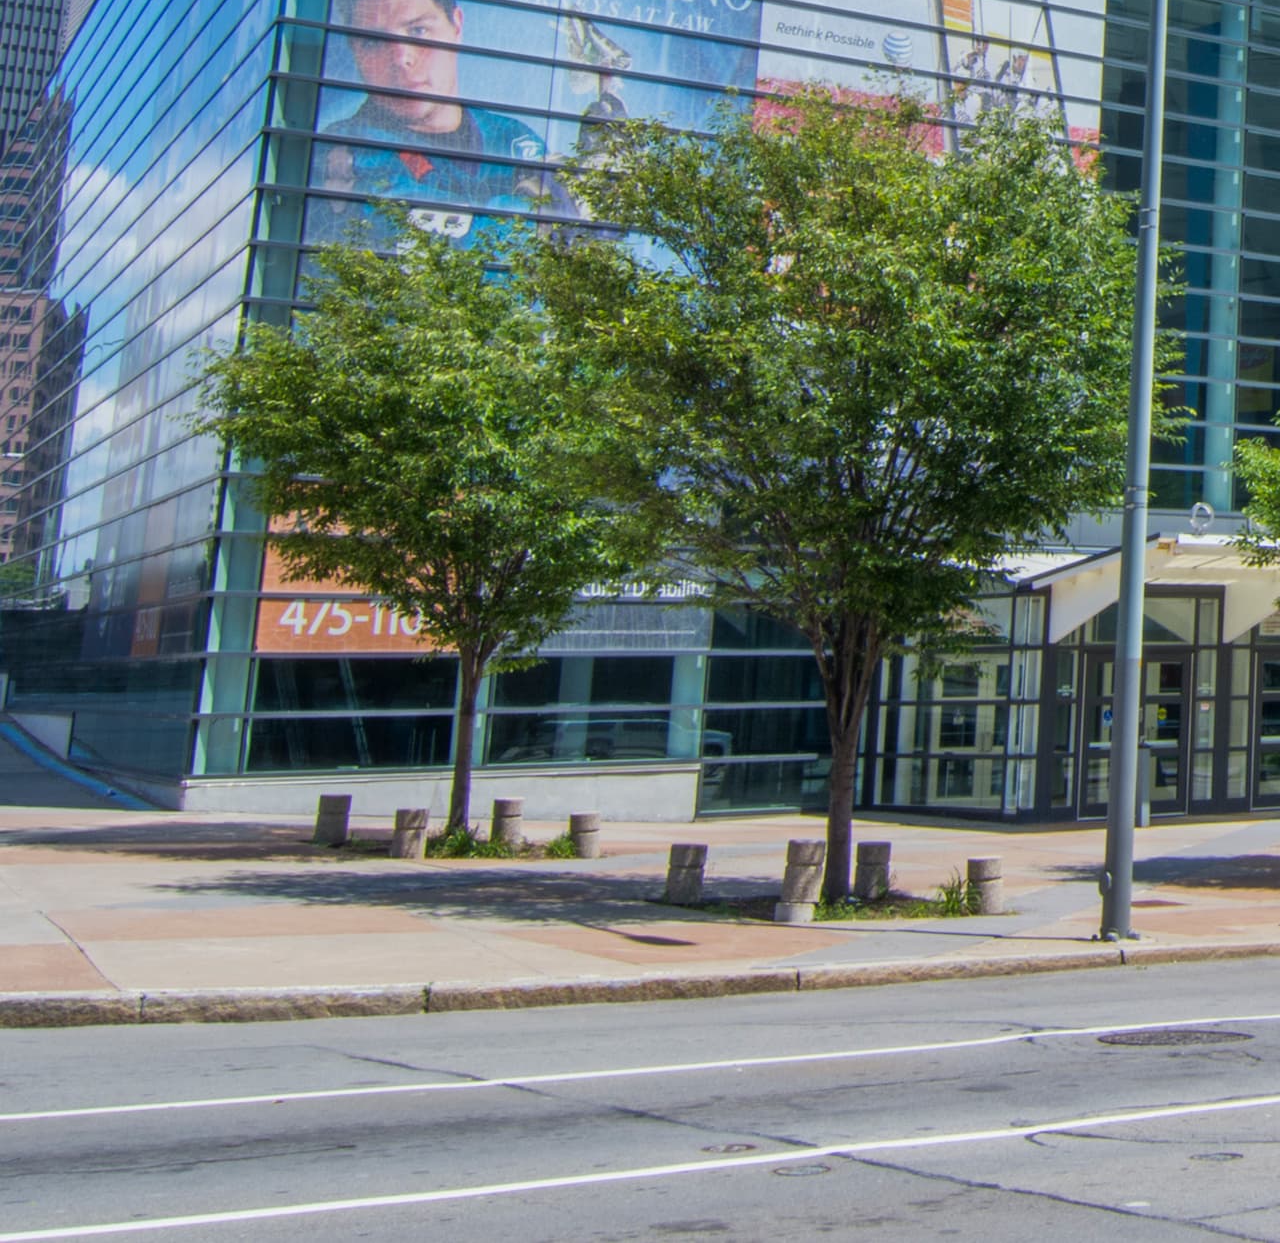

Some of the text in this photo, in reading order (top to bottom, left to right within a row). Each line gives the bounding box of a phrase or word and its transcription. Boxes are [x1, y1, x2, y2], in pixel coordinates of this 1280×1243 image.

[631, 4, 664, 25] AT
[666, 11, 715, 33] LAW
[776, 22, 875, 49] Rethink Possible
[279, 598, 428, 636] 475-110
